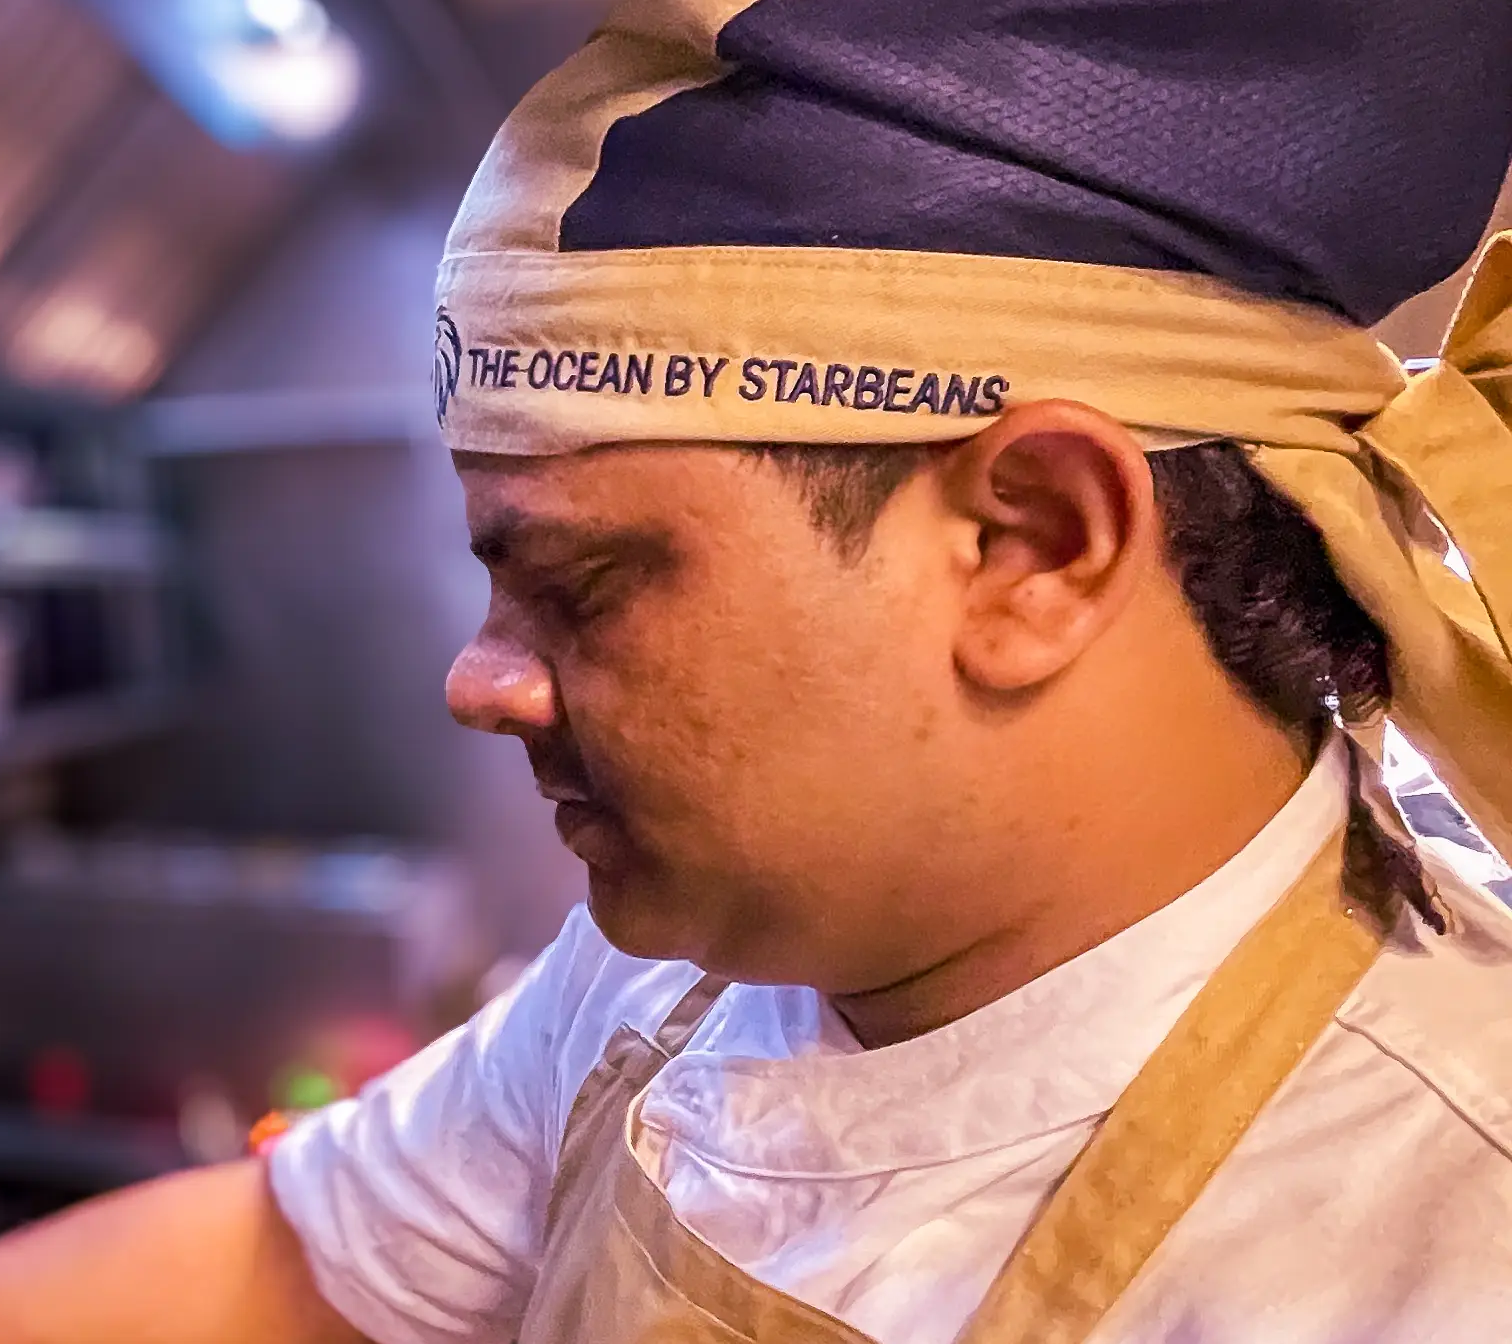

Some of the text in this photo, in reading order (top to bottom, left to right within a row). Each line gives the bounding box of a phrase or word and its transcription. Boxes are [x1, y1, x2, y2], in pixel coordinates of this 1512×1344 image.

[468, 348, 1010, 415] THE OCEAN BY STARBEANS
